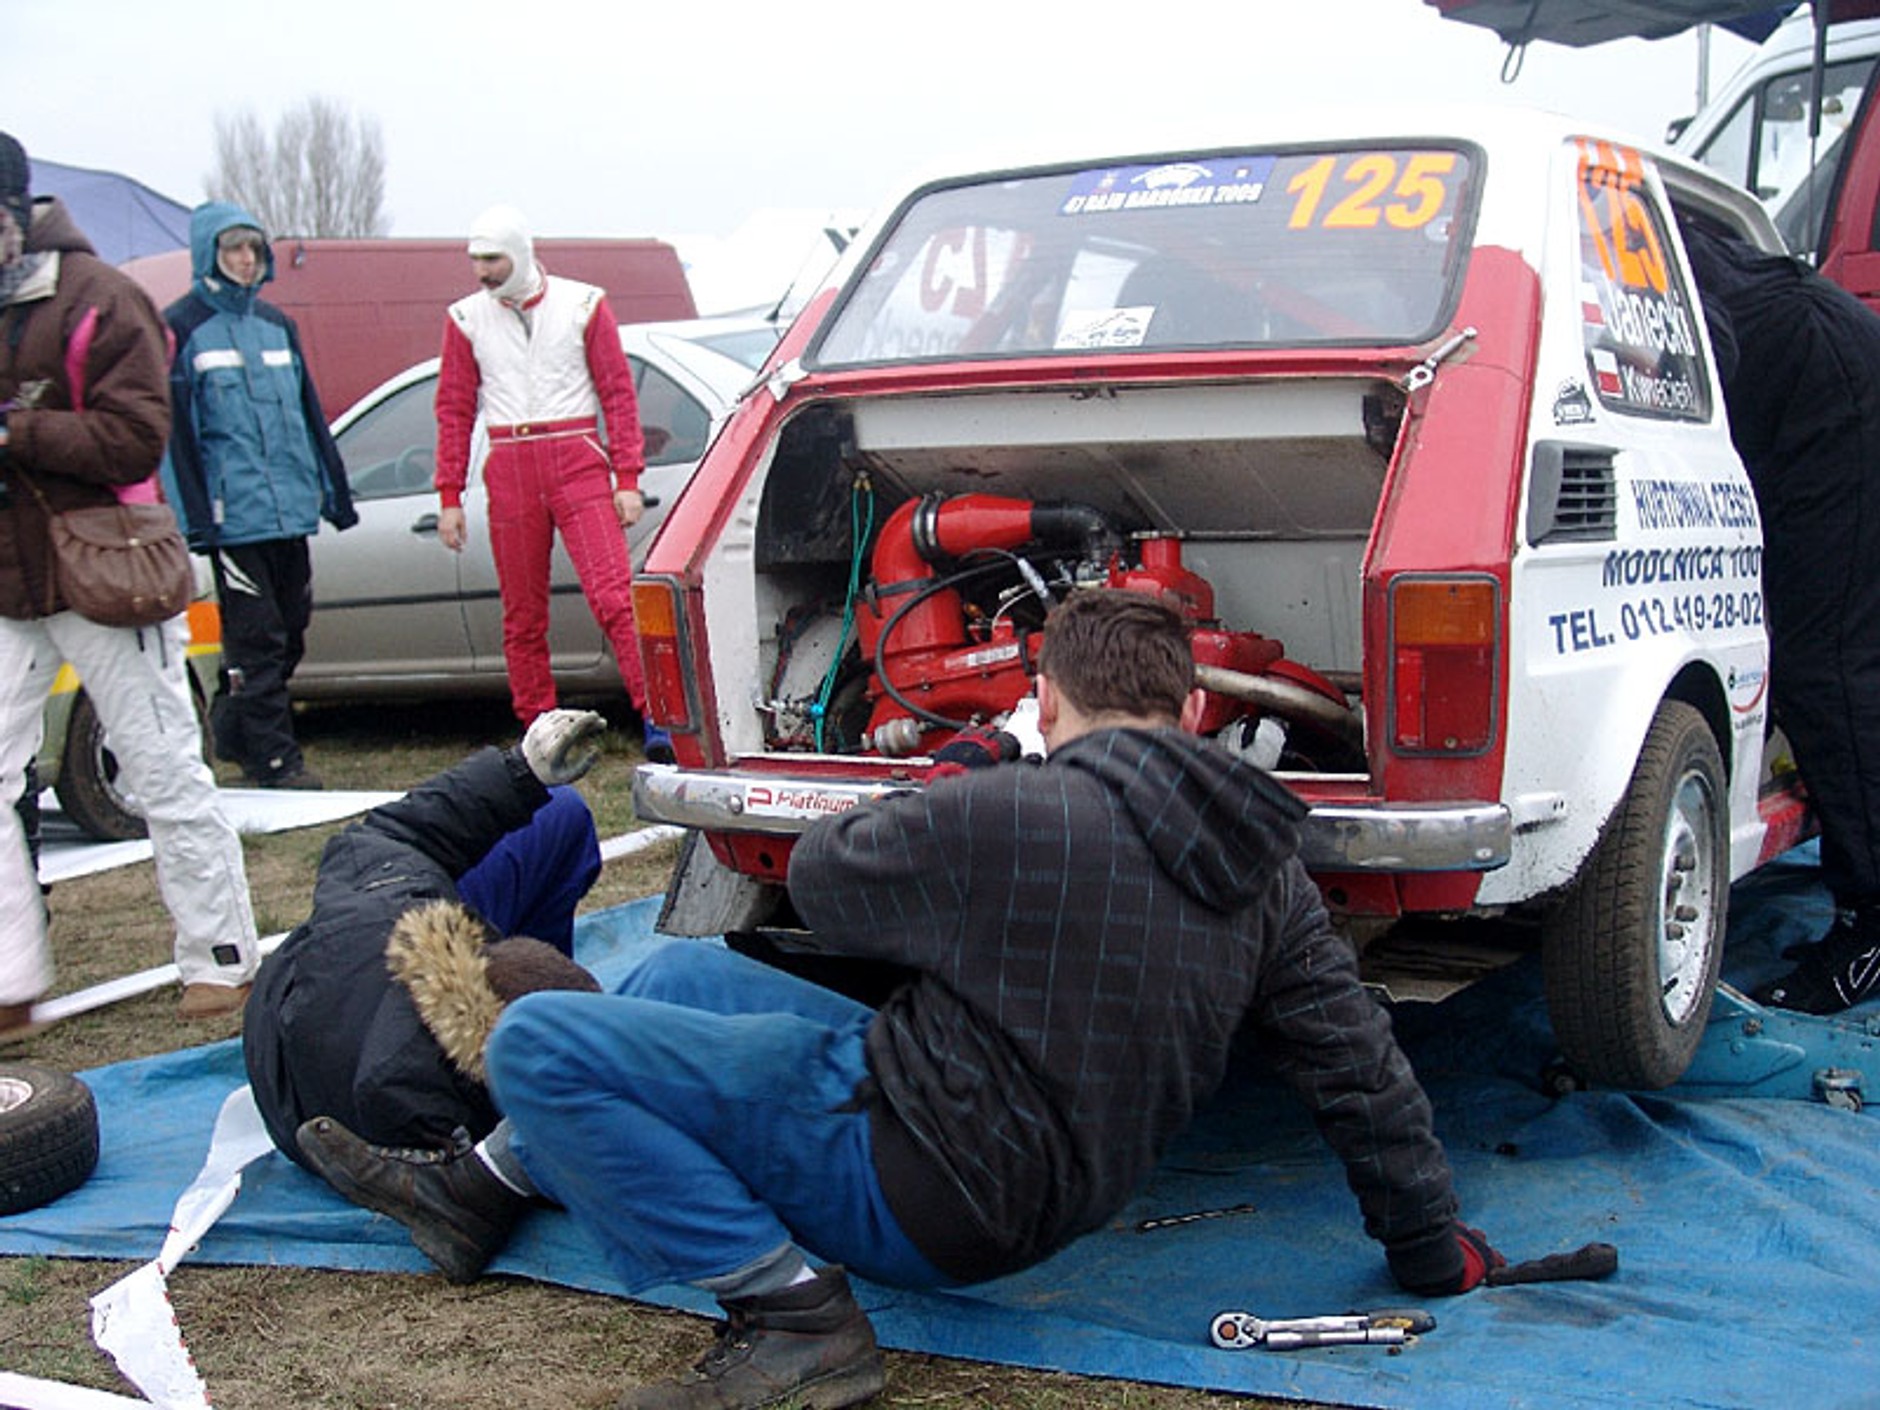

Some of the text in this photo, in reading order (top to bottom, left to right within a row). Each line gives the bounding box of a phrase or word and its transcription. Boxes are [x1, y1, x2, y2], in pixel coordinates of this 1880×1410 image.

[1286, 154, 1458, 230] 125
[1605, 282, 1696, 357] Janecki
[1631, 480, 1717, 530] HURTOWNIA
[1603, 545, 1762, 587] MODLNICA 100
[1549, 608, 1616, 656] TEL.
[776, 789, 856, 814] Platinum
